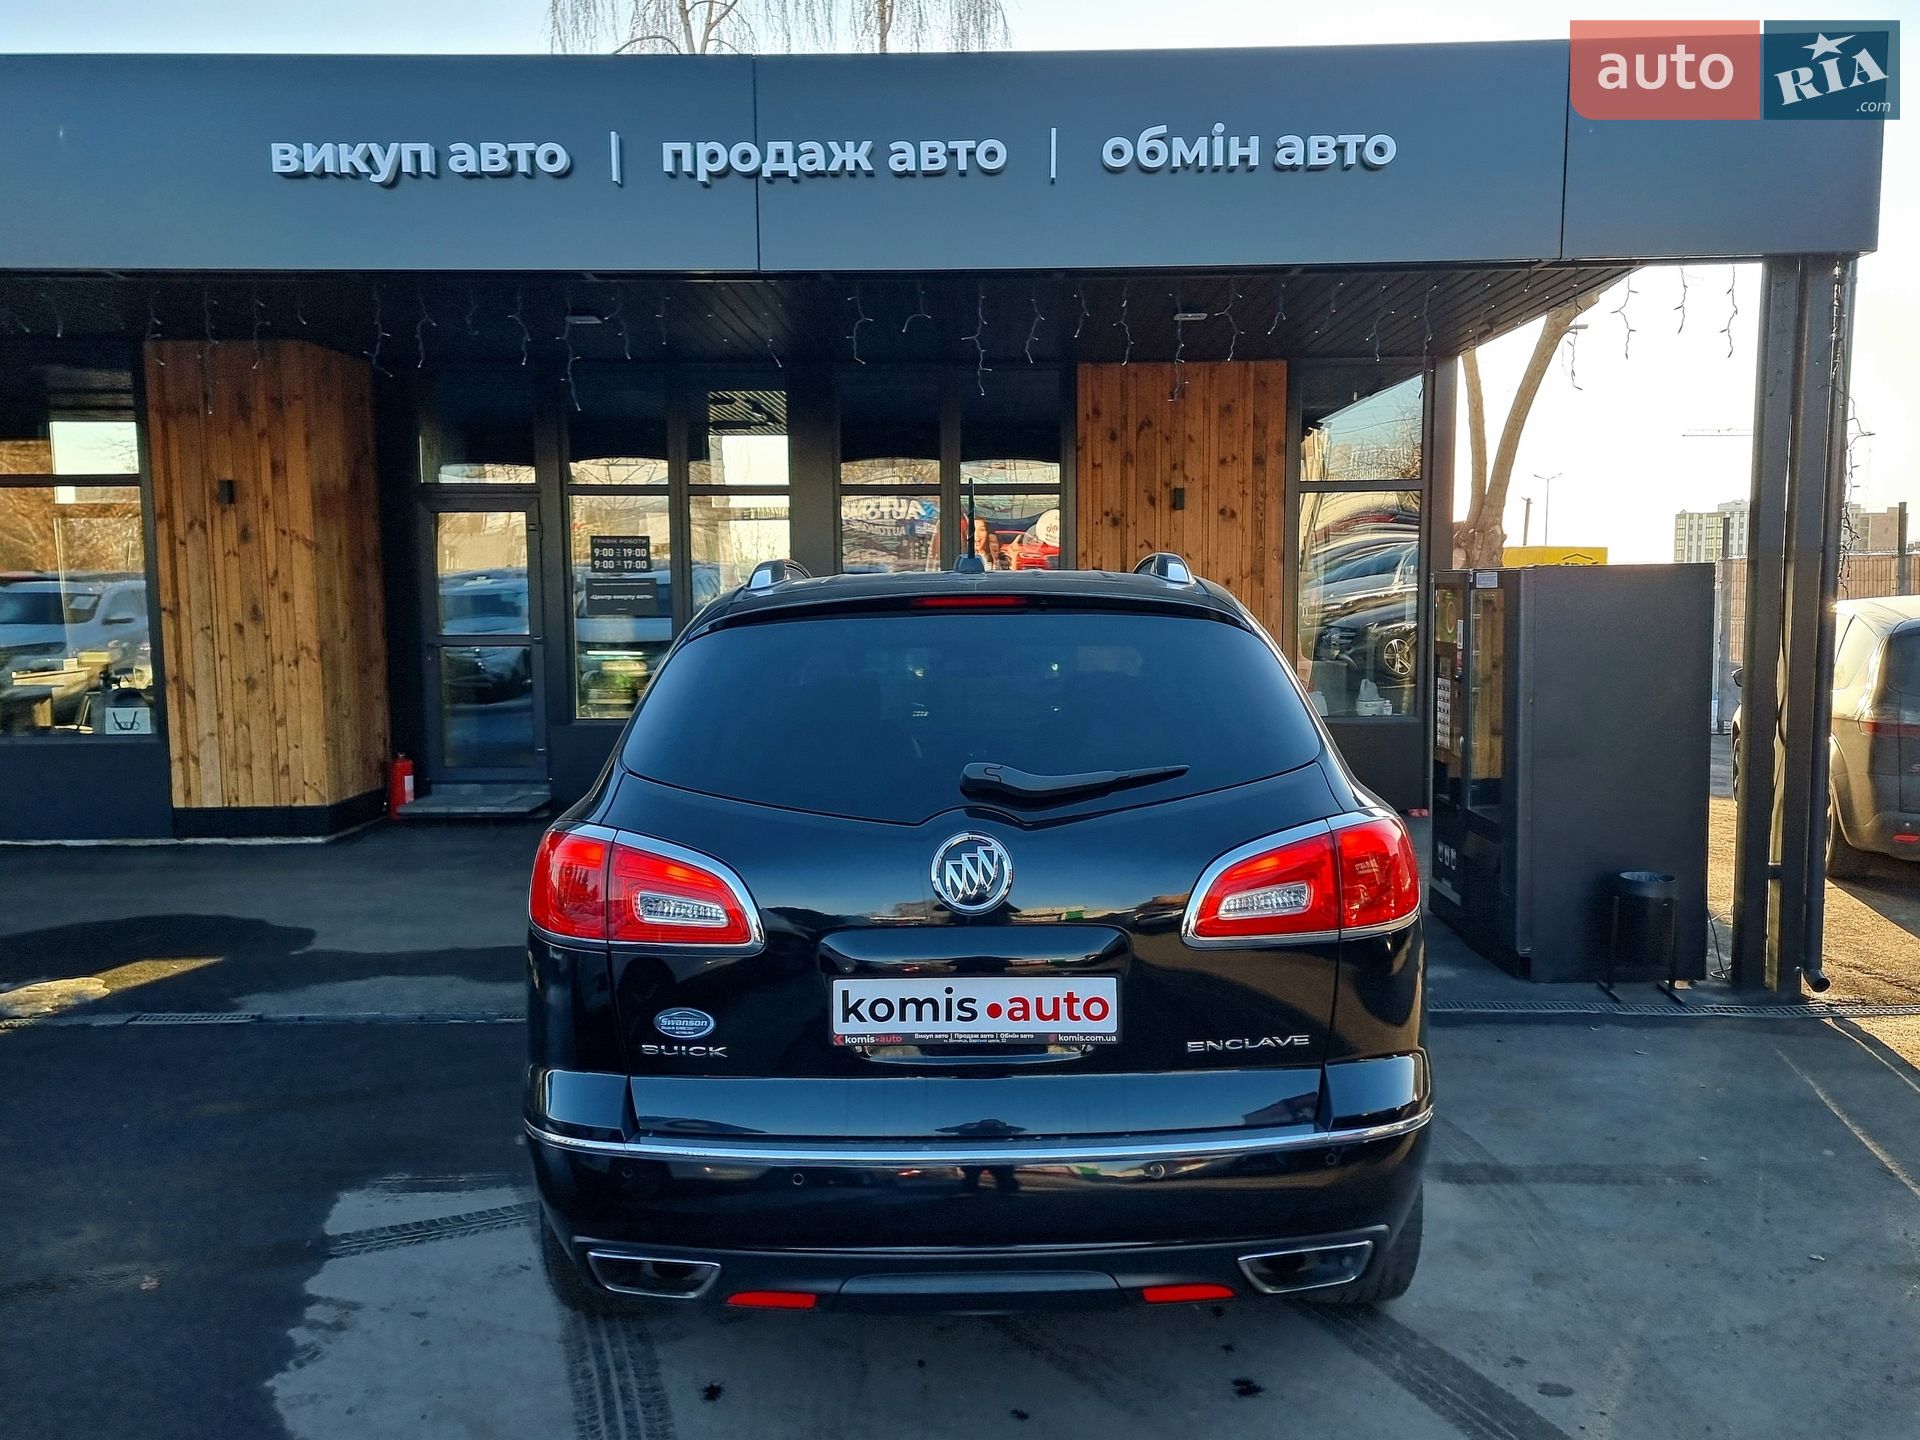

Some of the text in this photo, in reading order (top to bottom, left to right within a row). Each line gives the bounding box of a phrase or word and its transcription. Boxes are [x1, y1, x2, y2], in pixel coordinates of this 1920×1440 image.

[271, 142, 435, 186] викуп
[448, 141, 571, 177] авто
[662, 140, 875, 187] продаж
[888, 138, 1008, 176] авто
[1101, 122, 1260, 173] обмін
[1274, 133, 1398, 170] авто
[594, 548, 614, 557] 9:00
[622, 548, 648, 557] 19:00
[594, 560, 615, 569] 9:00
[623, 560, 648, 569] 17:00
[660, 1018, 708, 1027] Swanson
[1058, 1033, 1117, 1042] komis.com.ua
[1186, 1034, 1310, 1053] ENCLAVE
[641, 1044, 729, 1057] BUICK
